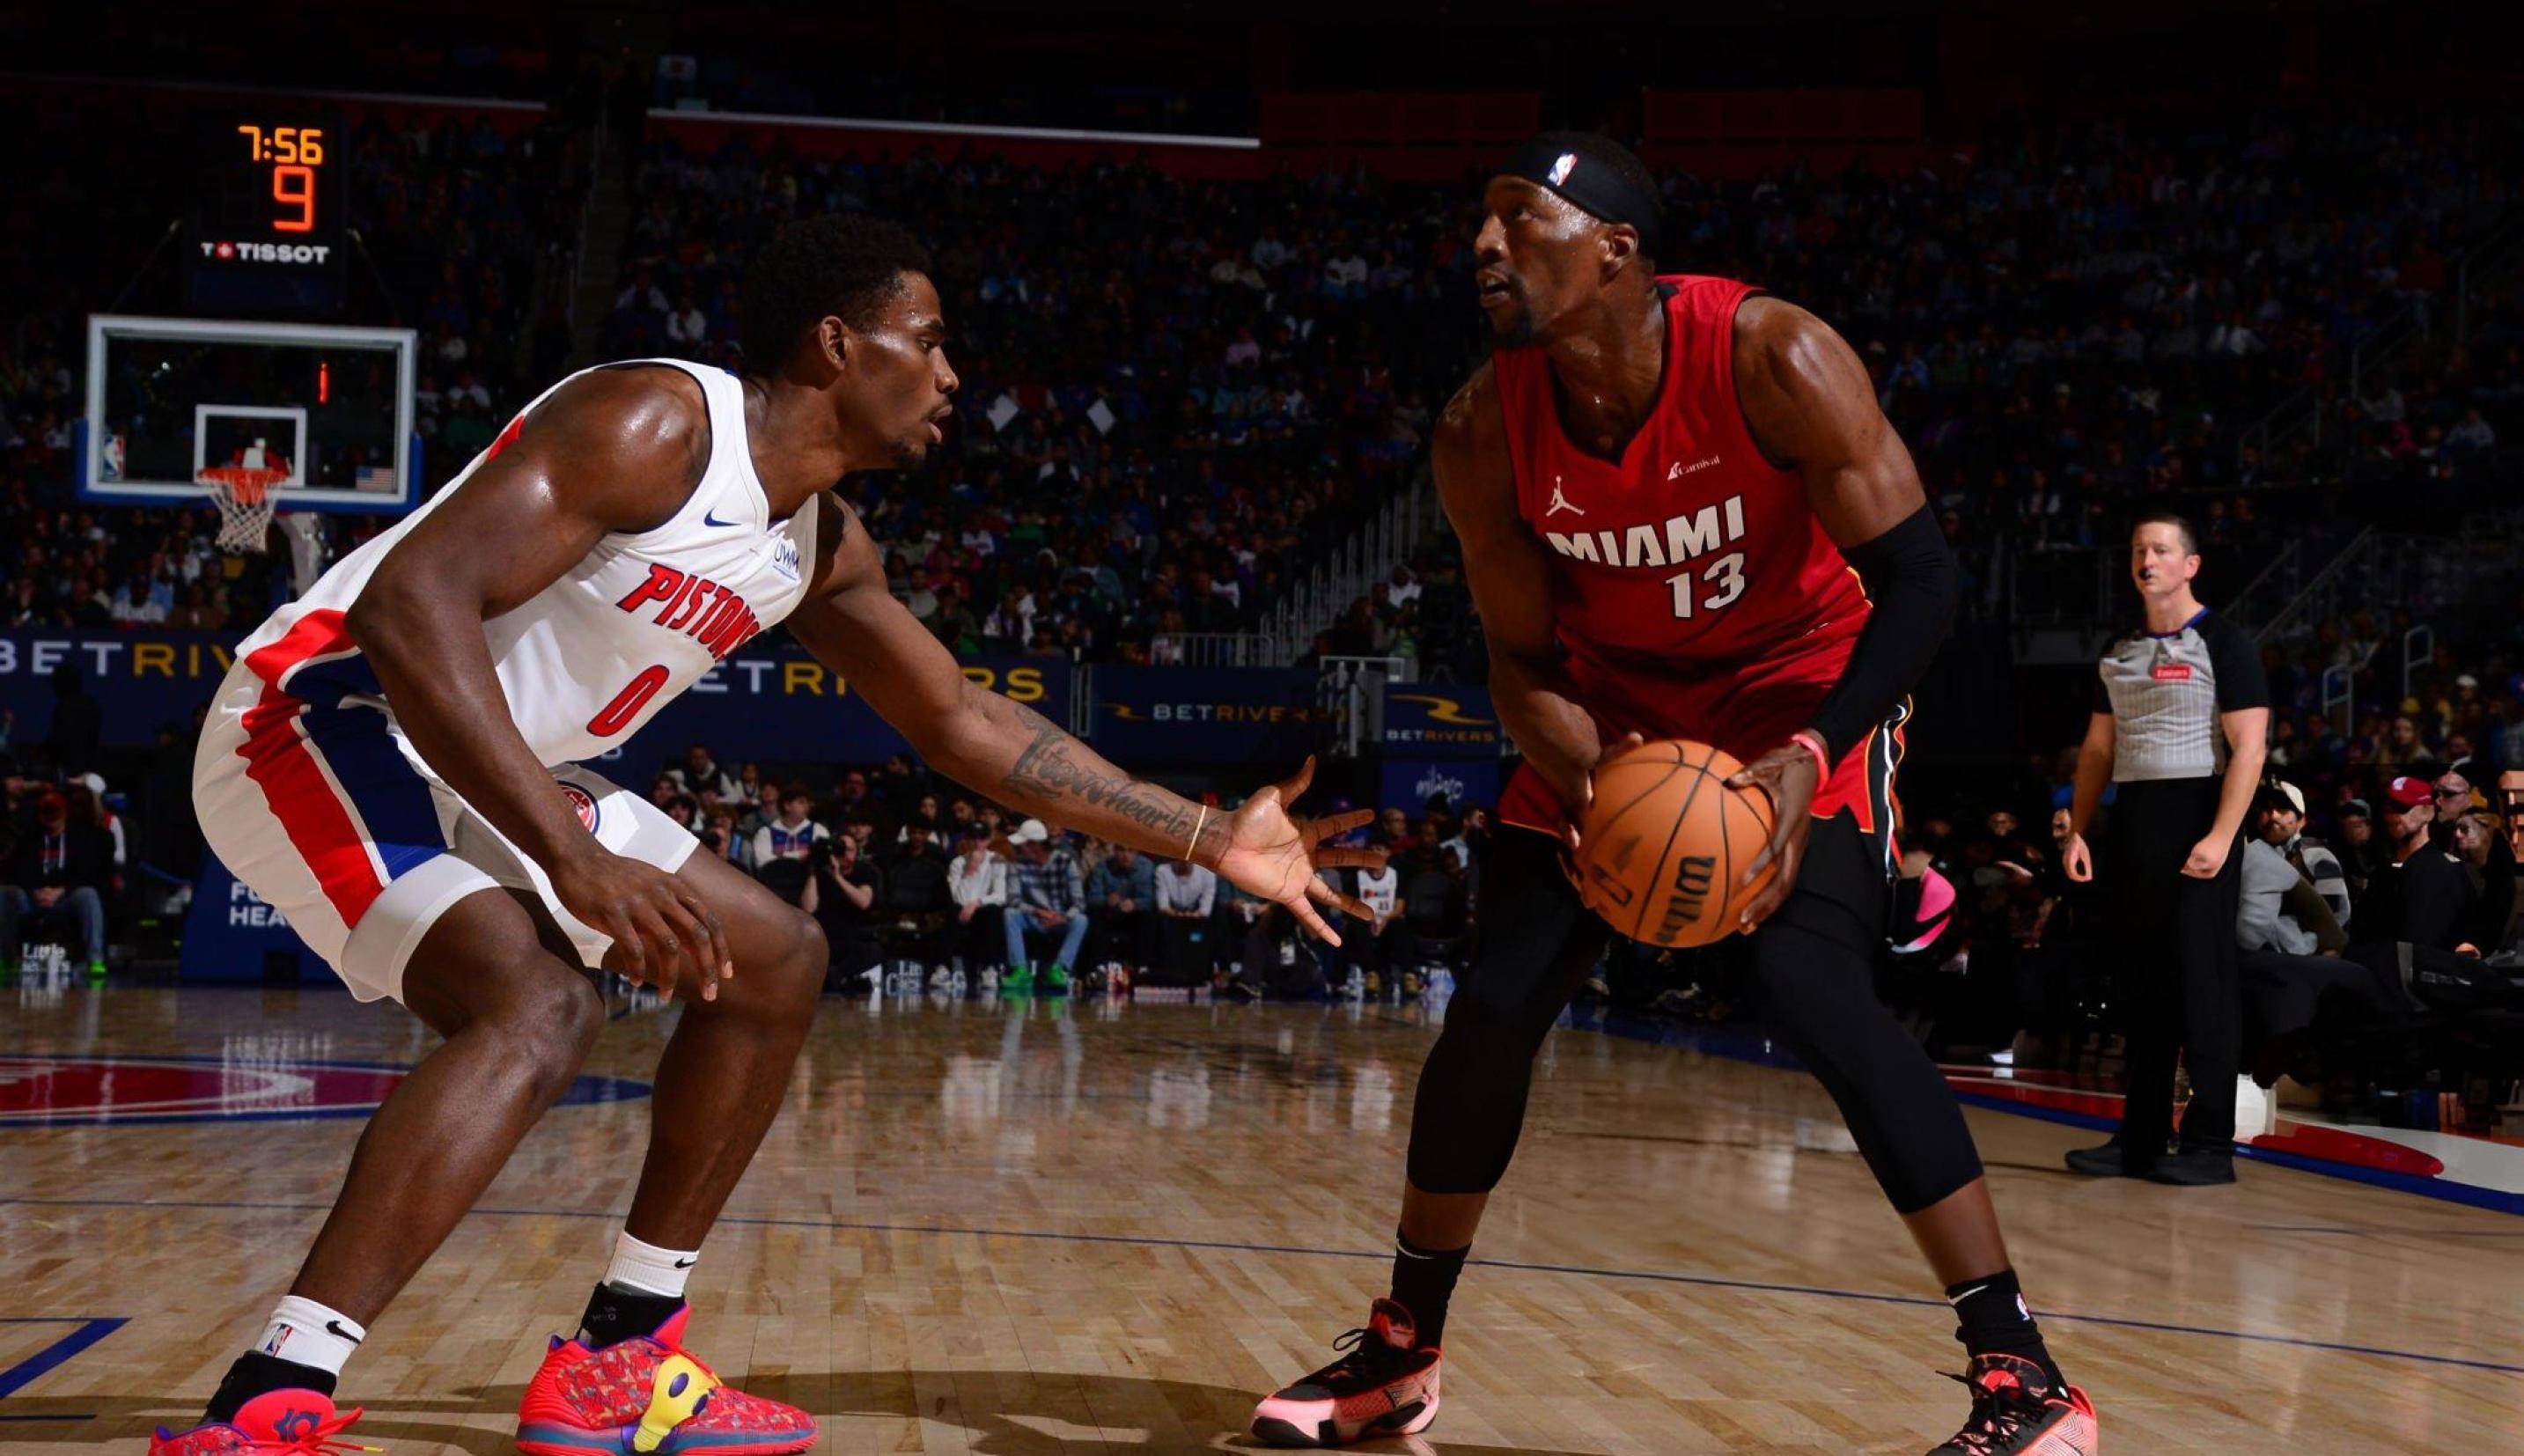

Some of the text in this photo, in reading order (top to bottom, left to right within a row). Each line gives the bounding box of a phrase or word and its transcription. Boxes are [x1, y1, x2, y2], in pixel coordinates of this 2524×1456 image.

[238, 124, 324, 165] 7:56
[272, 165, 316, 232] 9
[235, 242, 331, 265] TISSOT
[1545, 495, 1745, 568] MIAMI
[1665, 552, 1745, 618] 13
[586, 665, 670, 738] 0
[1386, 729, 1495, 741] BETRIVERS
